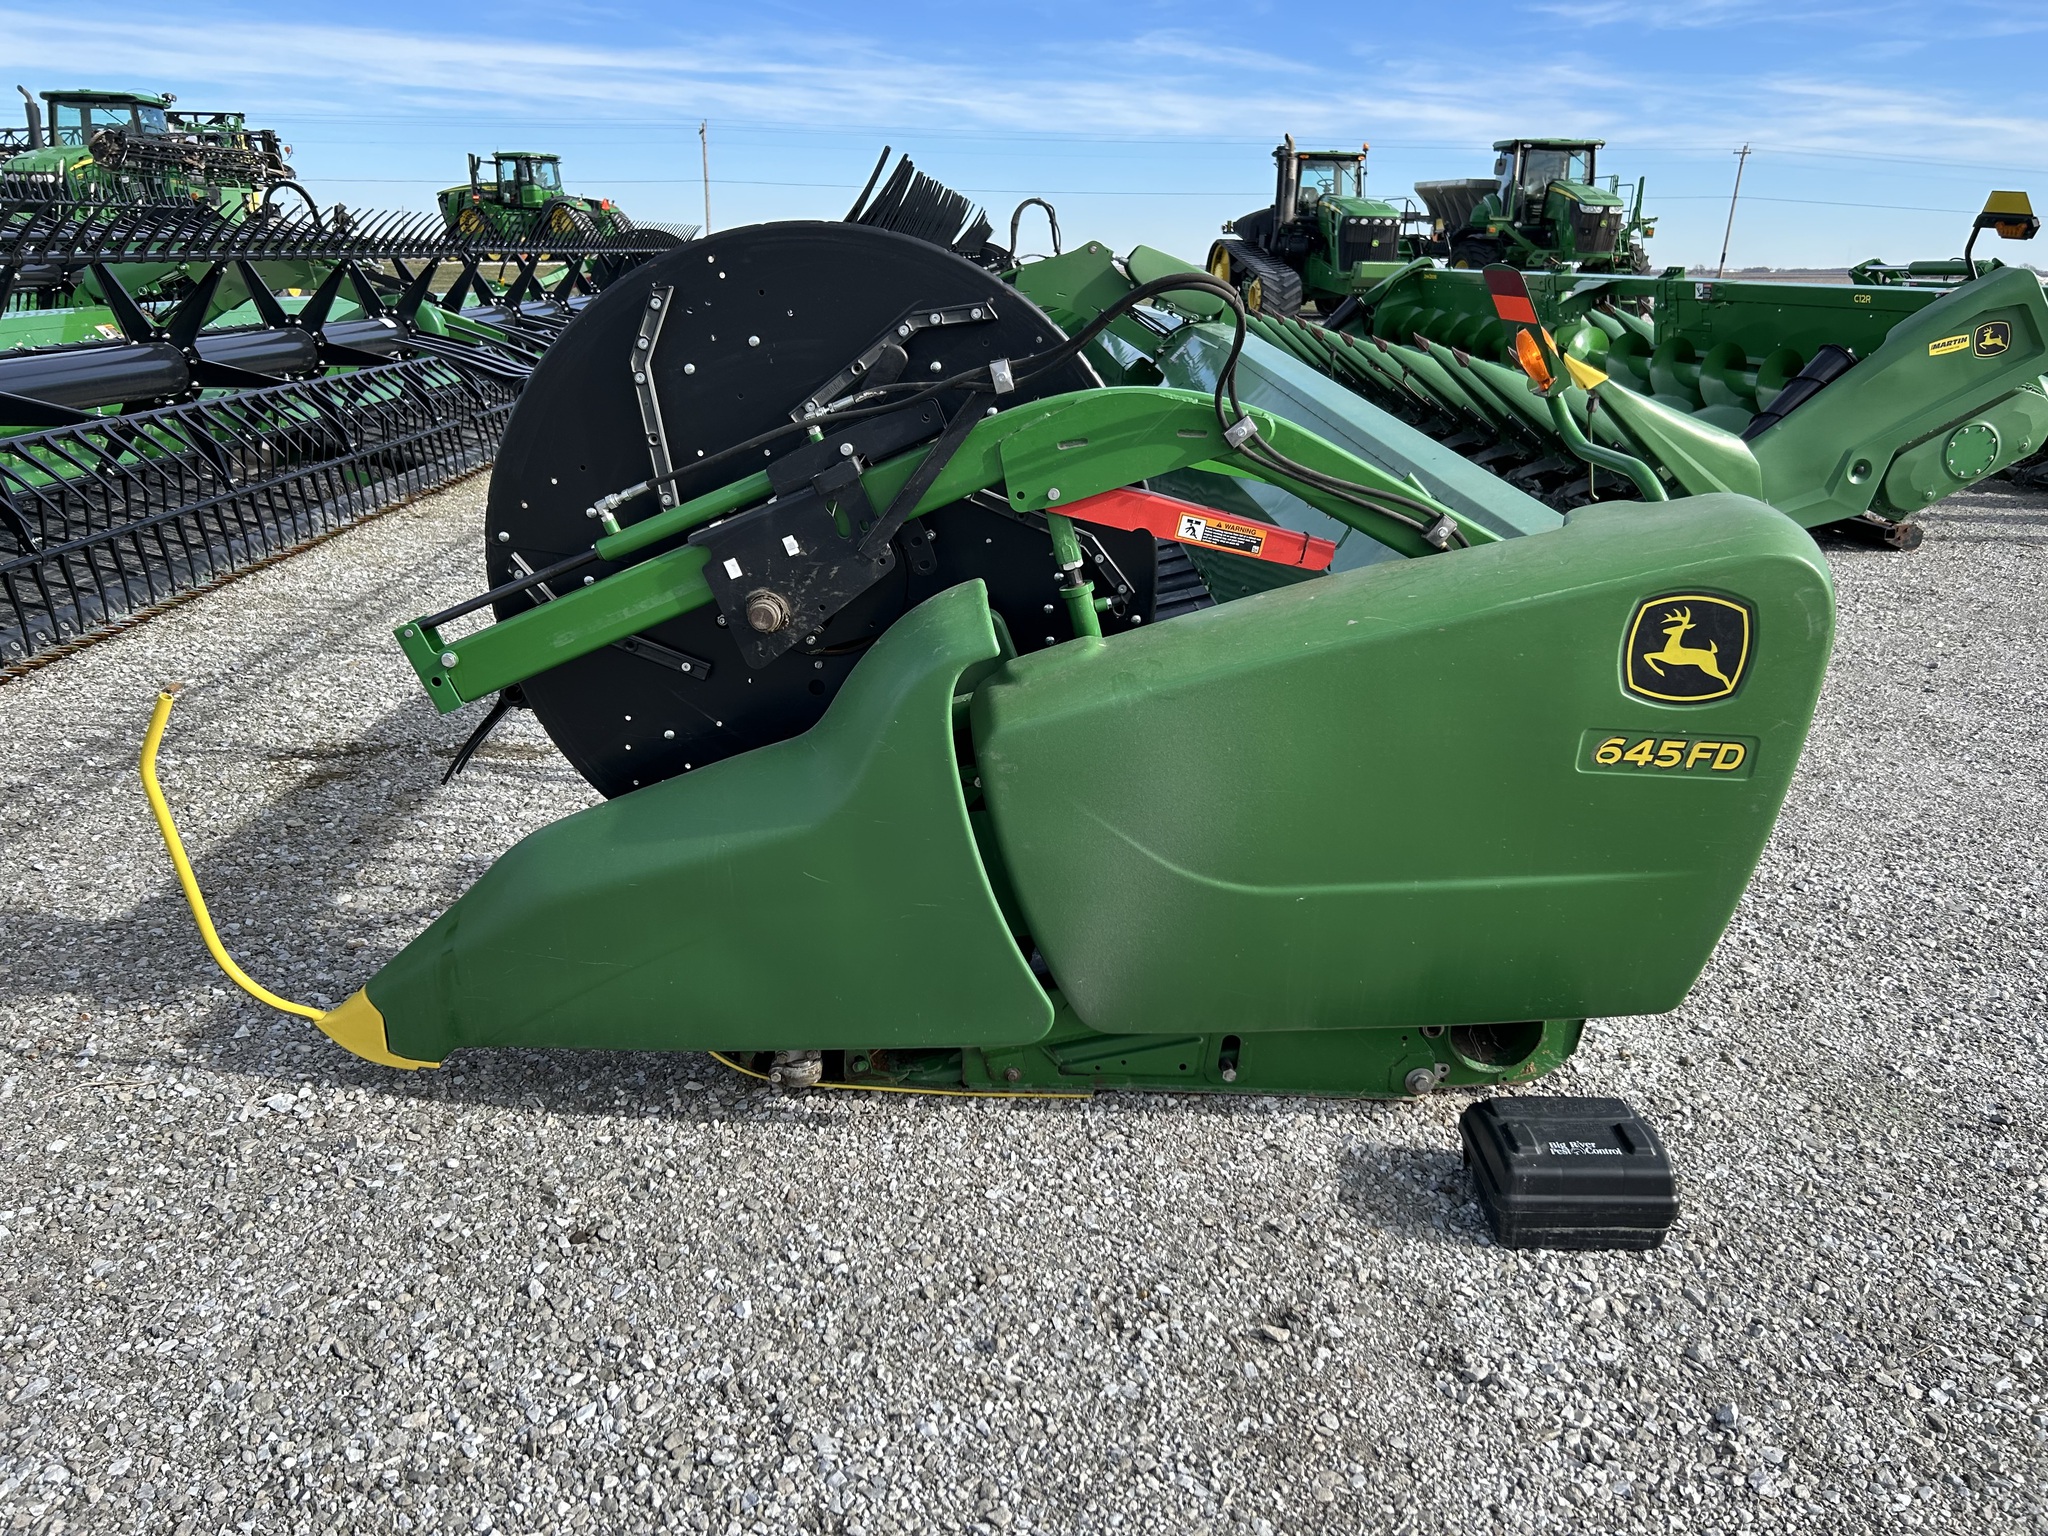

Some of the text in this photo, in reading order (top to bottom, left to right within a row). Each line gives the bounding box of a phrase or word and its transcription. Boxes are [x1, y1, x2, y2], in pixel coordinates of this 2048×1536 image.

[1853, 294, 1872, 304] C12R
[1932, 336, 1968, 350] MARTIN
[1224, 523, 1257, 536] WARNING
[1594, 736, 1747, 773] 645FD
[1548, 1140, 1596, 1149] Big River
